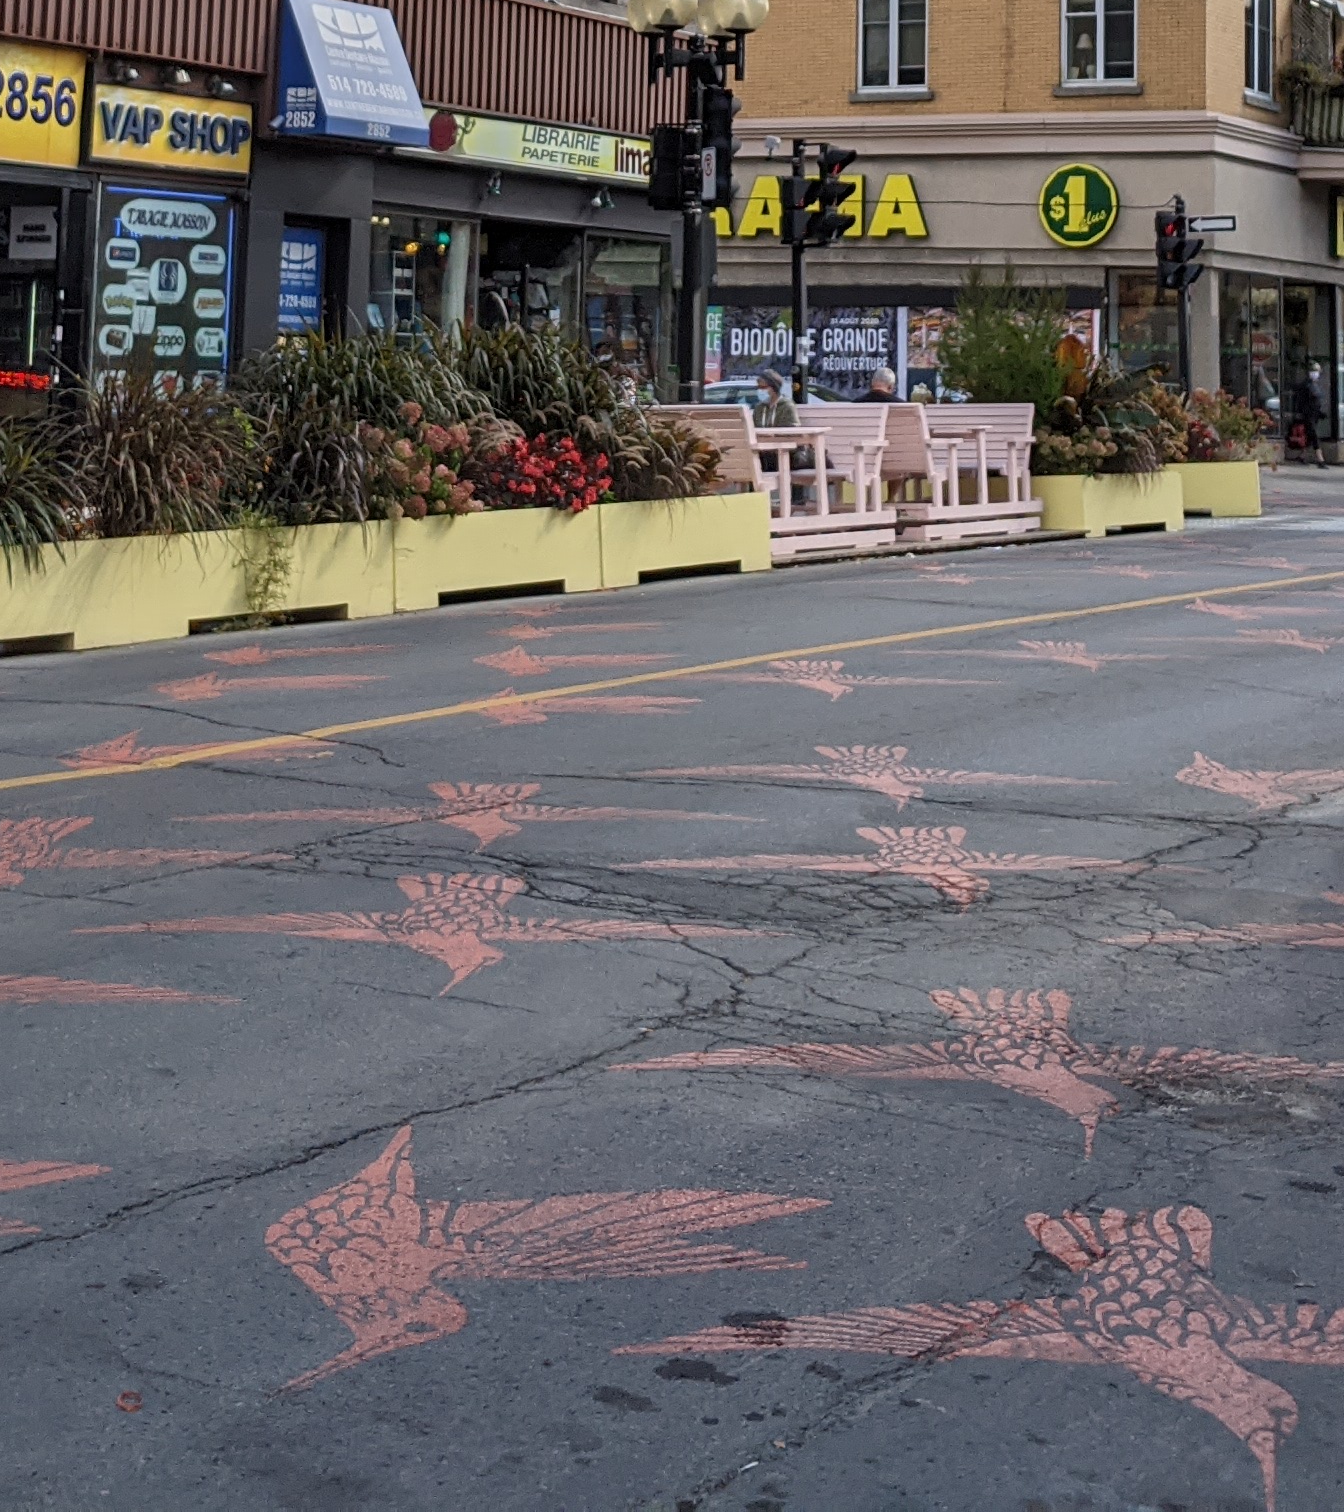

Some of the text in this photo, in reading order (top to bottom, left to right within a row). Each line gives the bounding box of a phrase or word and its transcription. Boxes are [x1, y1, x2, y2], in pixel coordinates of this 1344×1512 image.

[99, 100, 164, 146] VAP
[169, 108, 251, 156] SHOP
[284, 110, 316, 128] 2852
[367, 122, 391, 138] 2852
[521, 124, 602, 152] LIBRAIRIE
[521, 146, 600, 168] PAPETERIE
[731, 322, 889, 356] BIODÔE GRANDE
